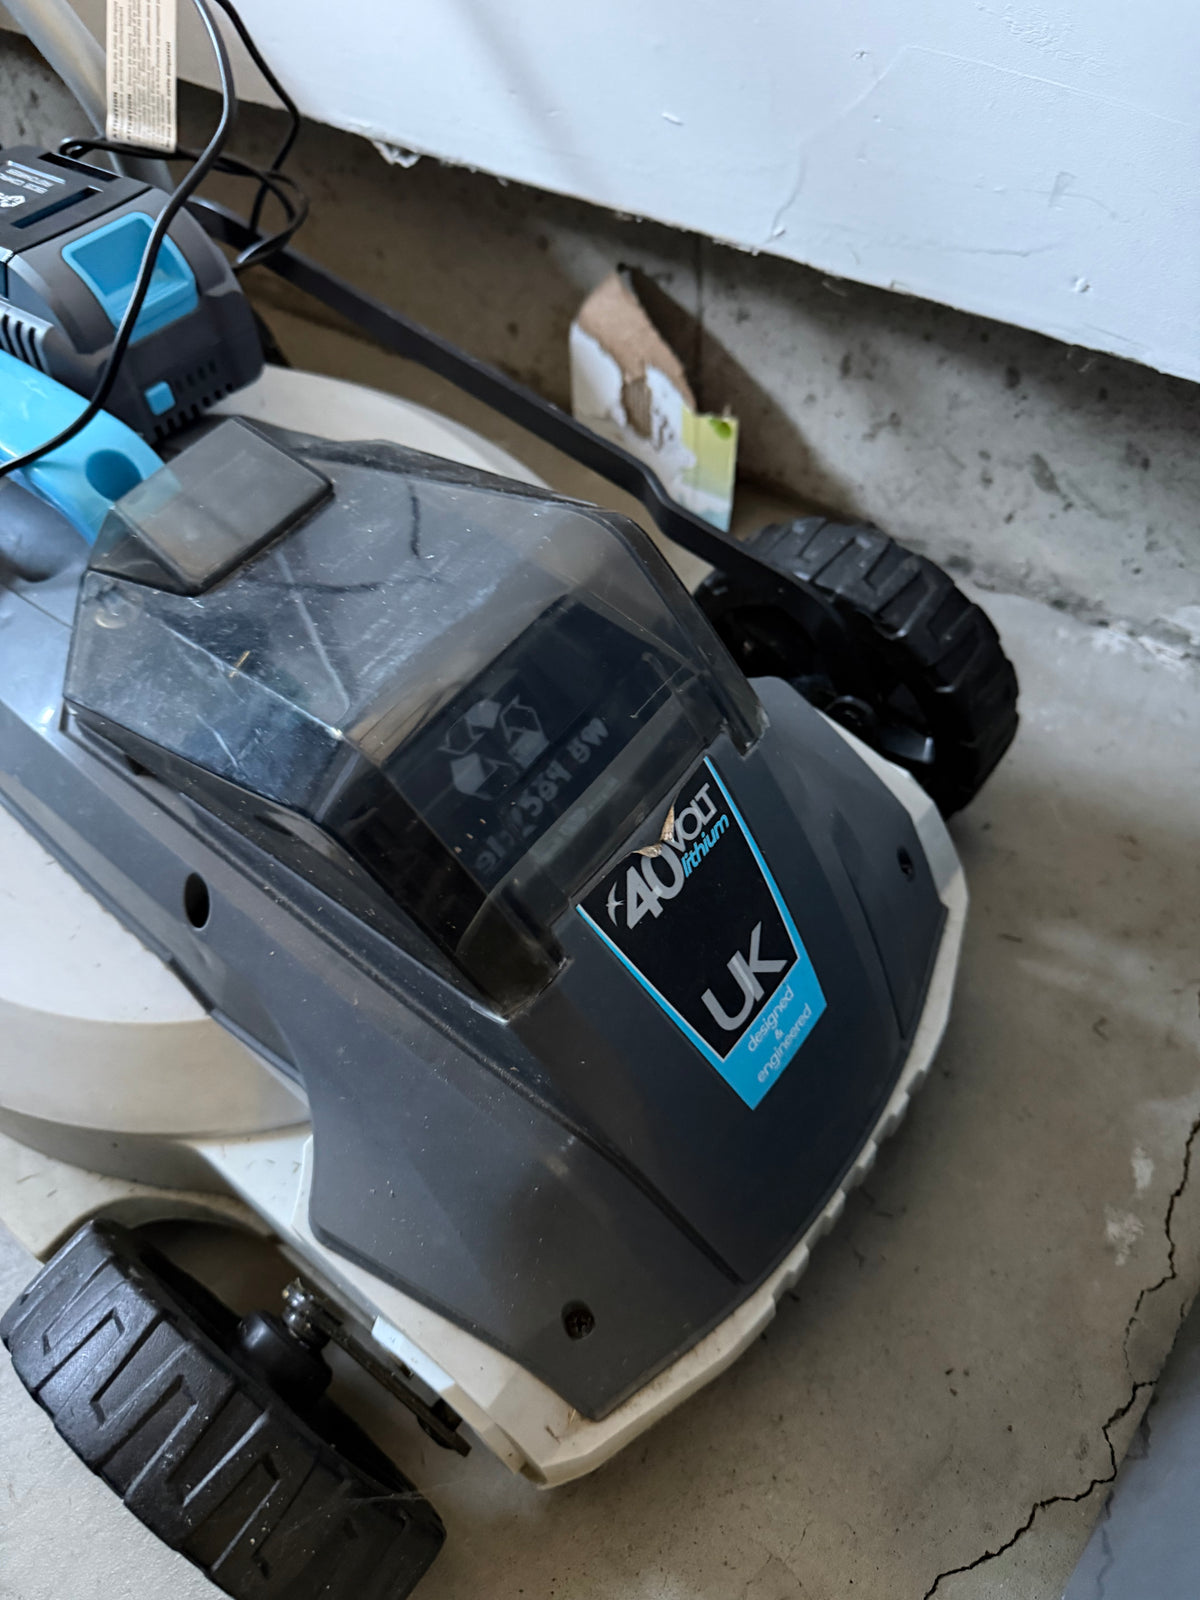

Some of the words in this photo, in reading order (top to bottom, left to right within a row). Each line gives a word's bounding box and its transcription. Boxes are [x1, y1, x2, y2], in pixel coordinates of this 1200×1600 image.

[681, 814, 730, 878] lithium
[701, 920, 788, 1031] UK
[747, 985, 794, 1052] designed
[757, 1002, 812, 1084] engineered
[774, 1028, 785, 1041] &
